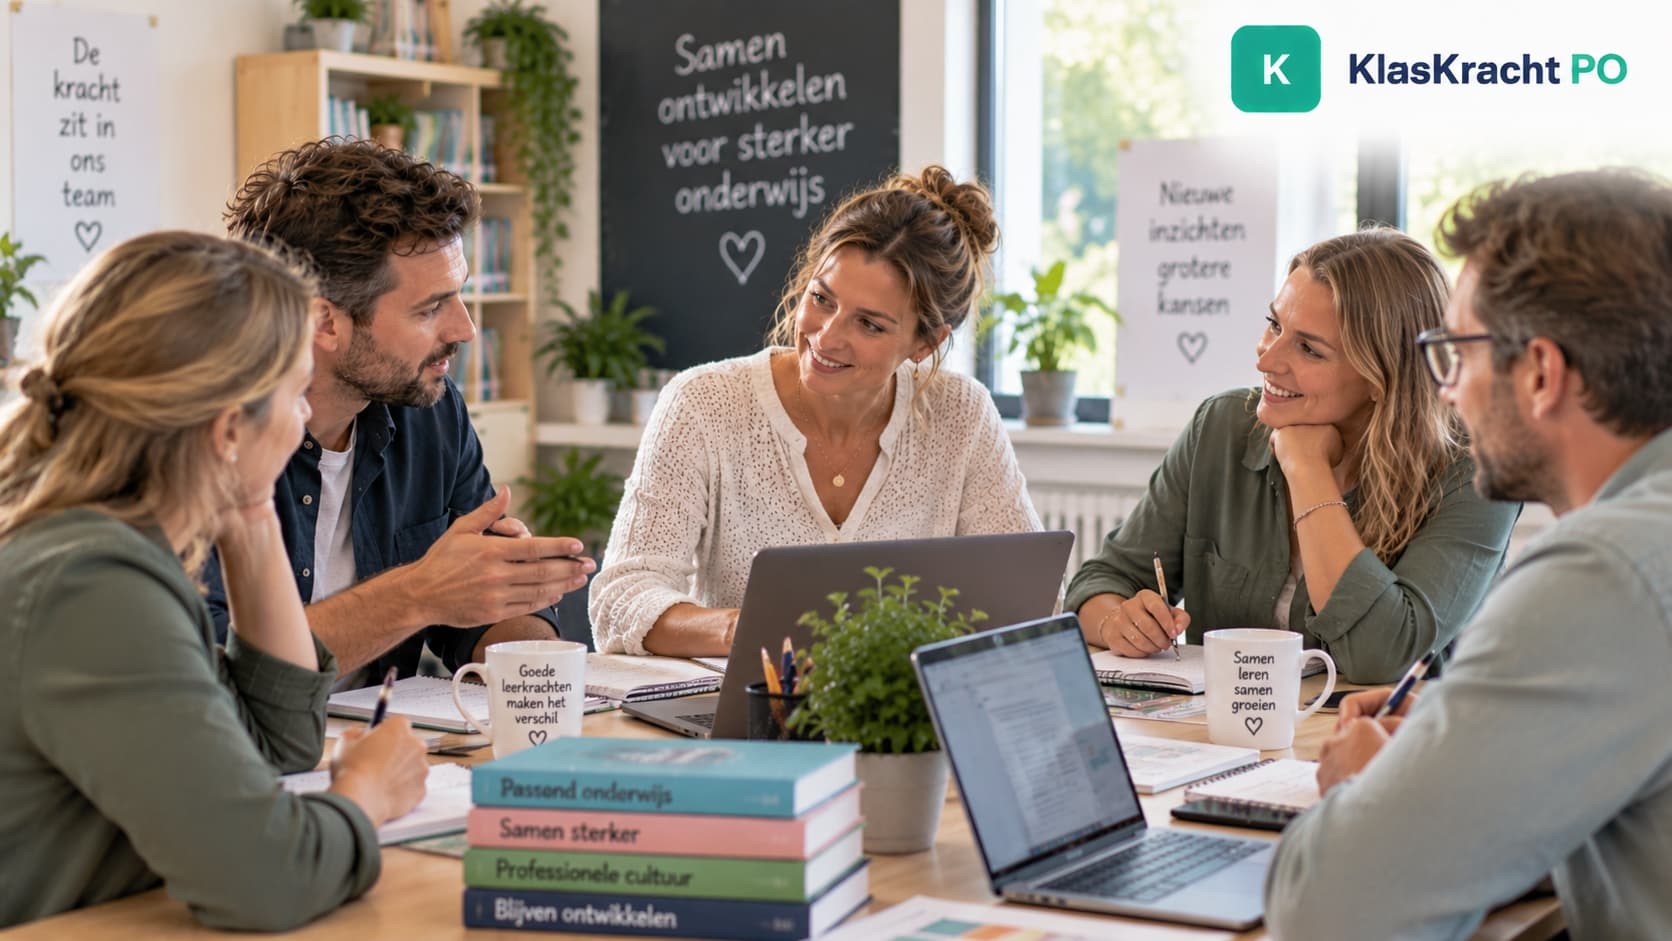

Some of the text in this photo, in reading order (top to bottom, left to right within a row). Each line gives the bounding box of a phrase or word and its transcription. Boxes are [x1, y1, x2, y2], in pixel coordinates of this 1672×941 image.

[72, 36, 100, 66] De
[674, 32, 787, 77] Samen
[53, 69, 121, 103] kracht
[657, 63, 848, 126] ontwikkelen
[58, 112, 116, 138] zit in
[661, 112, 855, 168] voor sterker
[70, 155, 106, 174] ons
[62, 181, 116, 207] team
[674, 166, 826, 219] onderwijs
[1159, 181, 1234, 206] Nieuwe
[1149, 215, 1246, 242] inzichten
[1157, 255, 1231, 288] grotere
[1157, 289, 1230, 316] kansen
[519, 663, 556, 677] Goede
[1233, 650, 1275, 665] Samen
[501, 678, 572, 694] leerkrachten
[1238, 666, 1269, 680] leren
[506, 695, 566, 709] maken het
[1234, 686, 1273, 696] samen
[515, 711, 559, 725] verschil
[1231, 698, 1276, 714] groeien
[499, 776, 674, 808] Passend onderwijs
[499, 817, 641, 844] Samen sterker
[495, 857, 694, 888] Professionele cultuur
[494, 897, 678, 930] Blijven ontwikkelen
